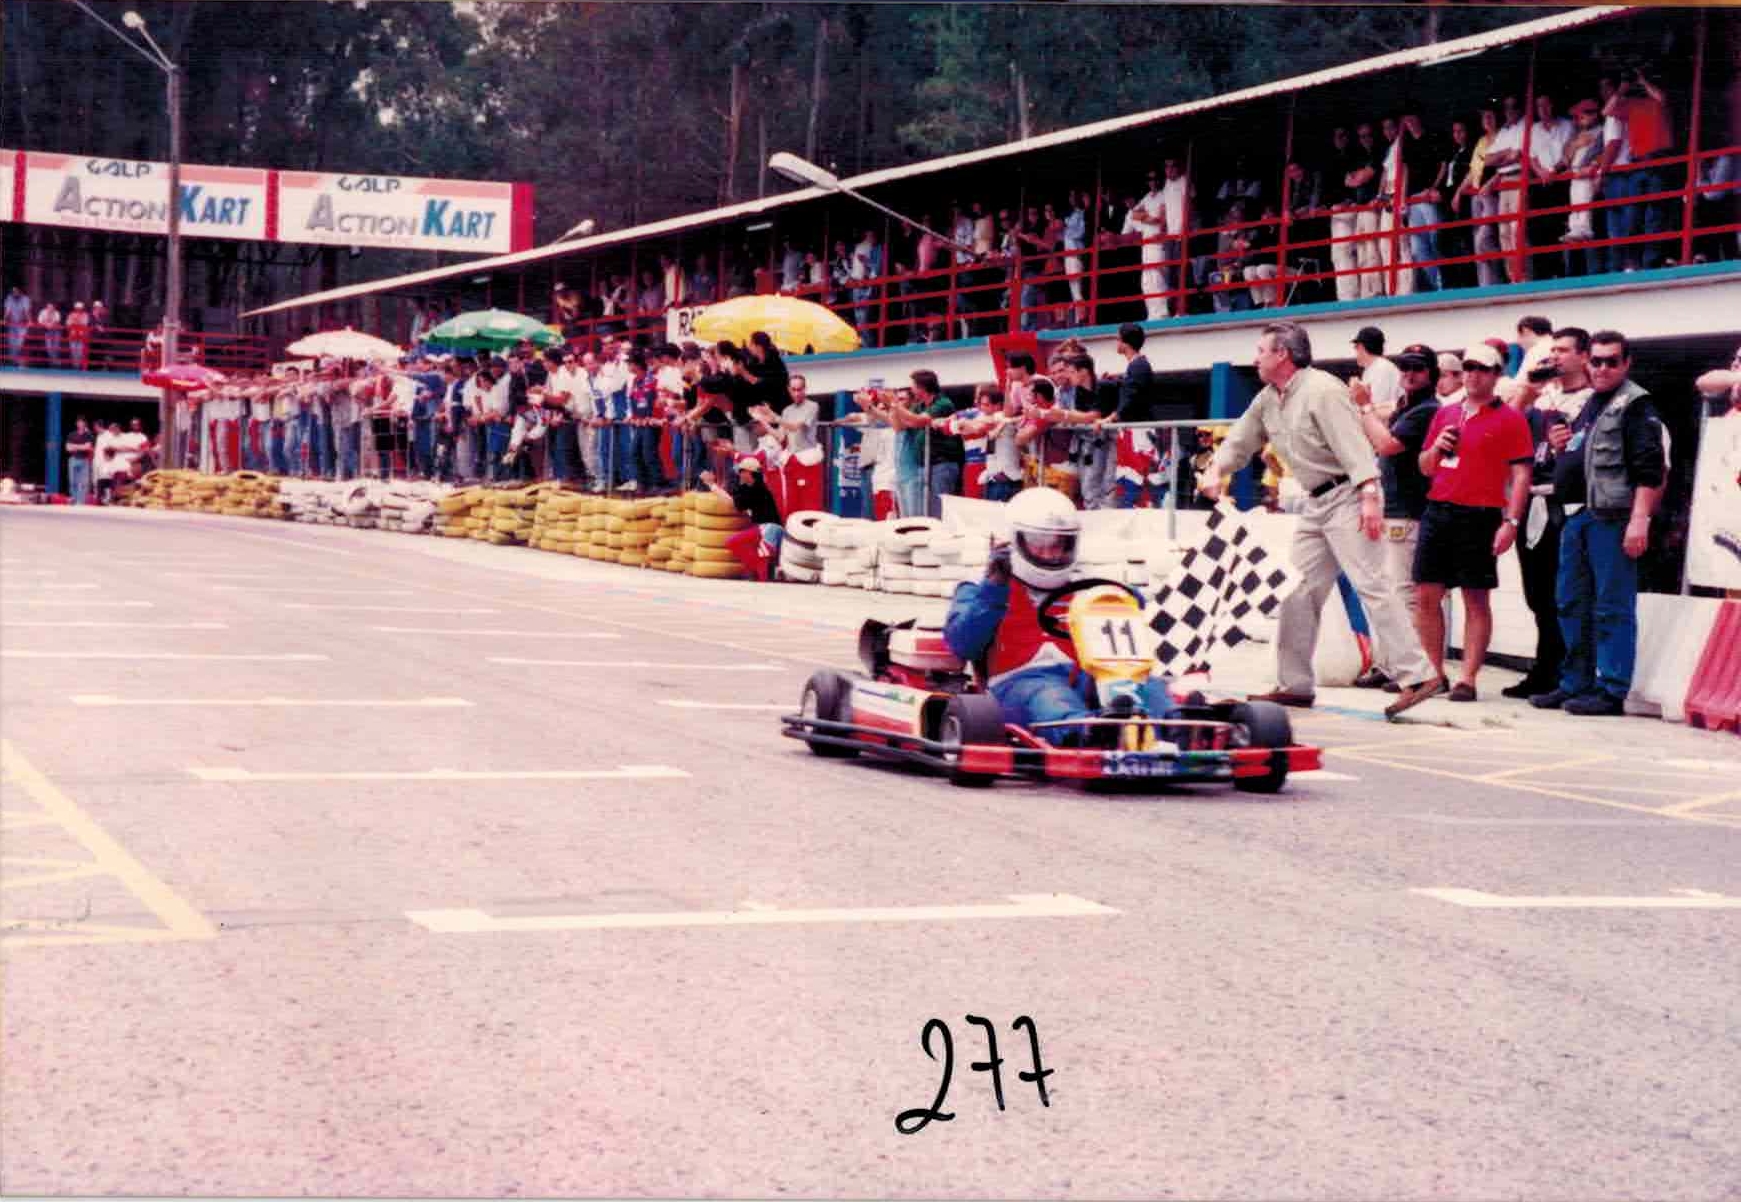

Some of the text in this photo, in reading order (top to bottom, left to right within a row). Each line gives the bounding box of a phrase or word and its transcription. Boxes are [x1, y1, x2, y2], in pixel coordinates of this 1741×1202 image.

[86, 159, 151, 178] GALP
[337, 176, 401, 193] GALP
[54, 175, 252, 225] ACTION KART
[305, 193, 497, 239] ACTION KART
[1101, 619, 1136, 656] 11
